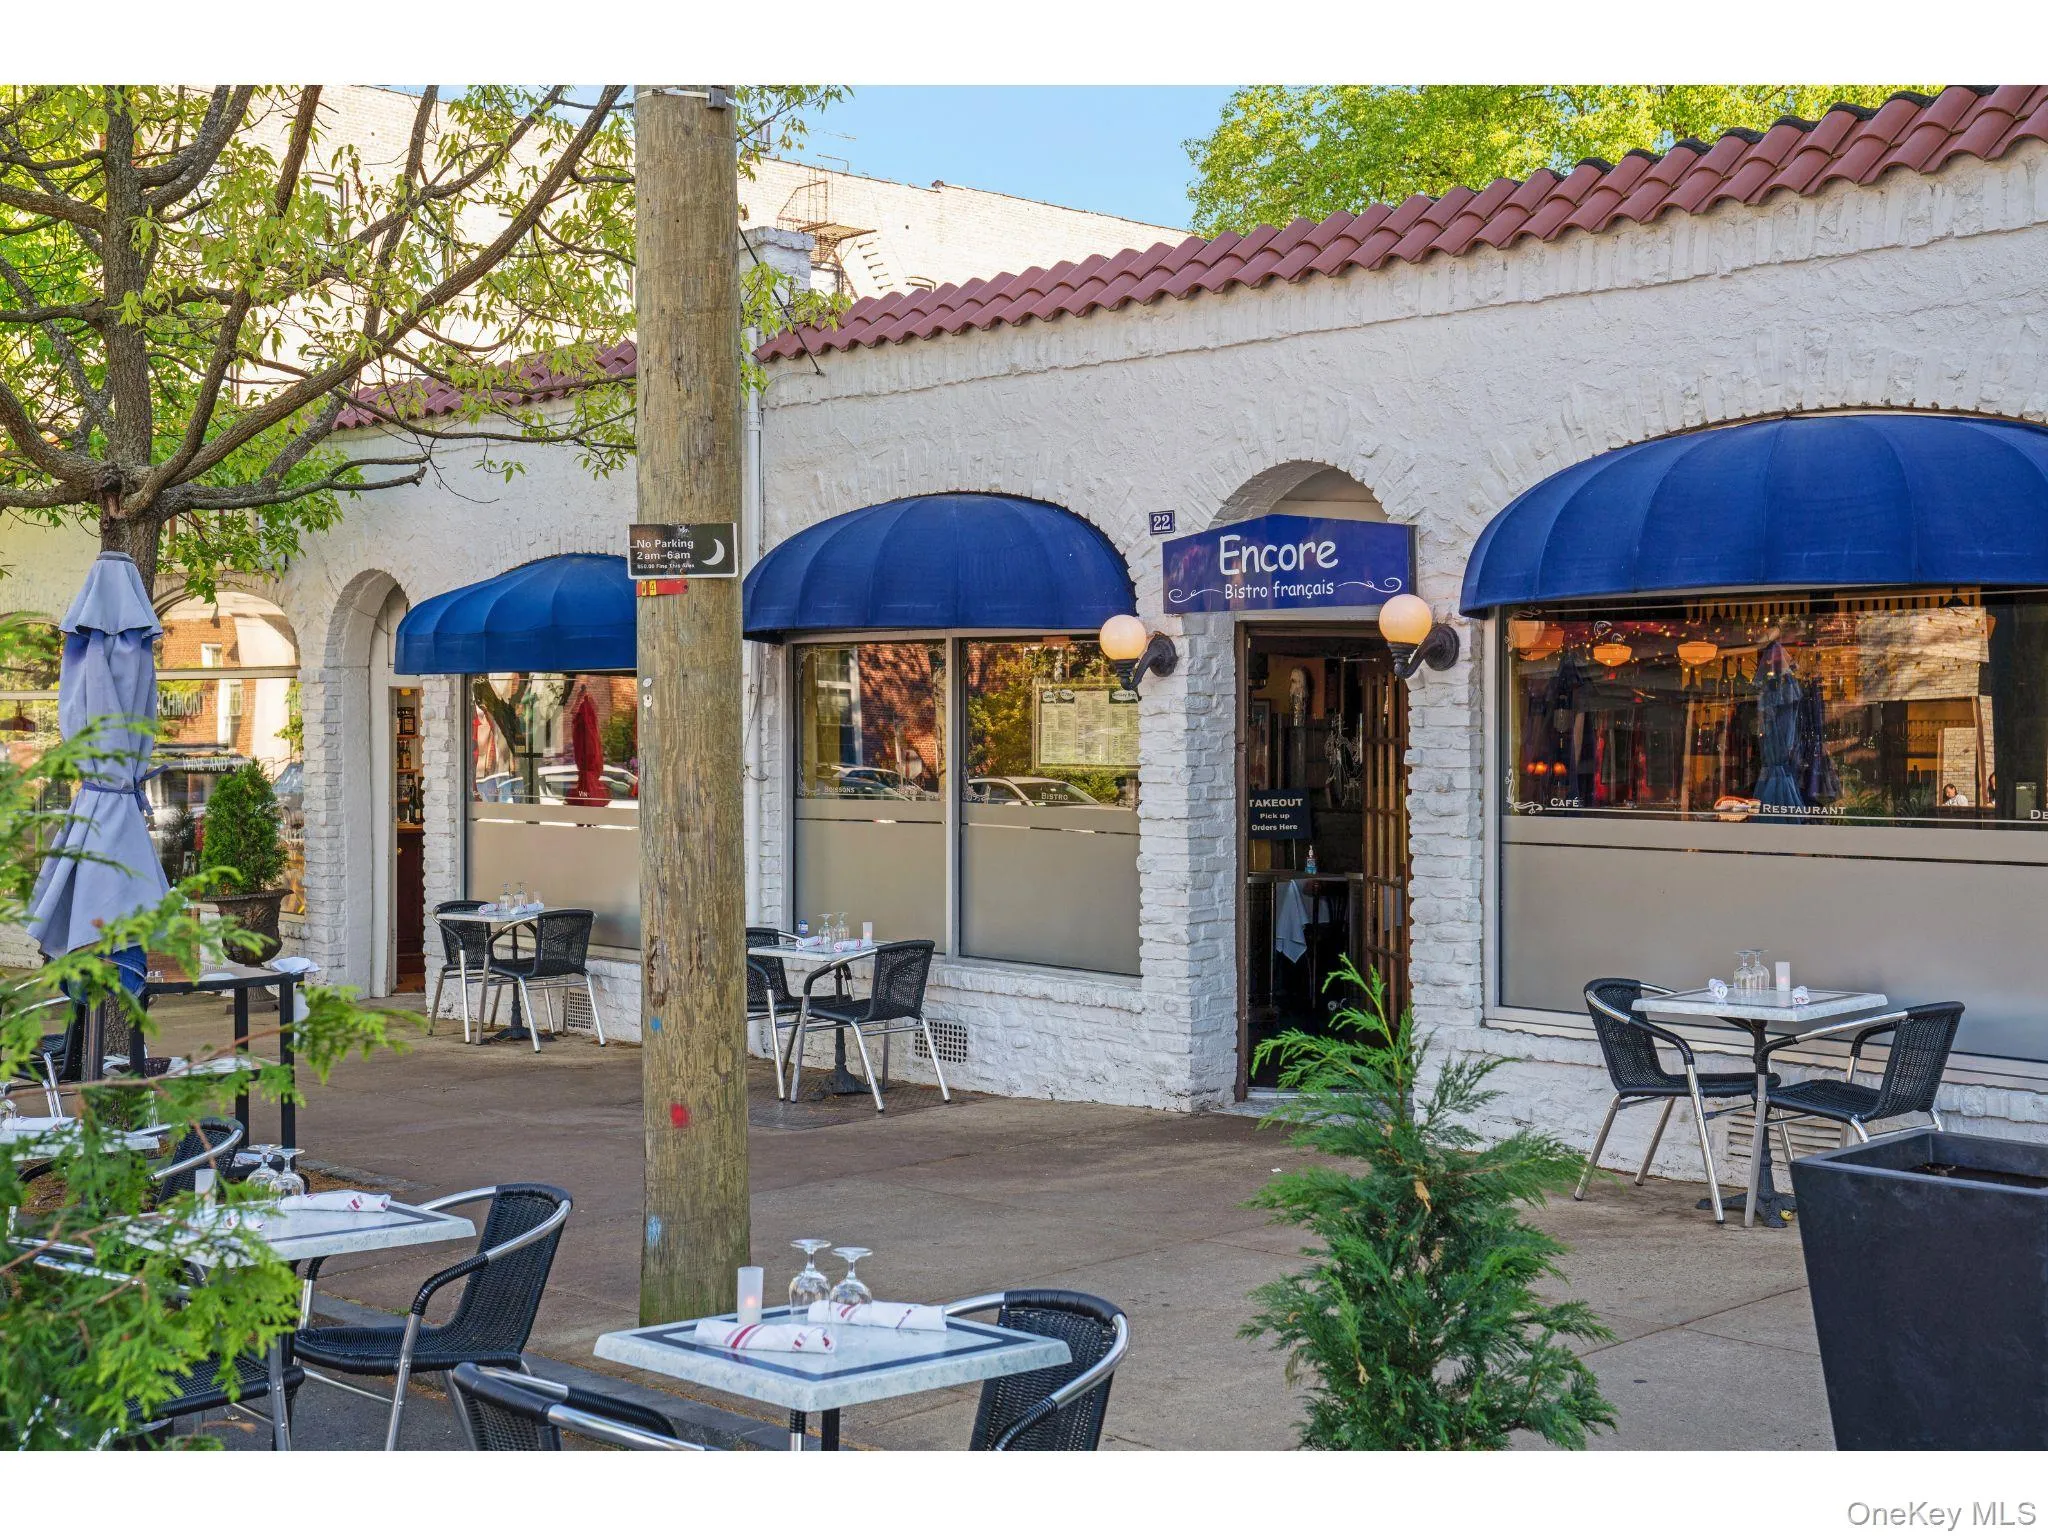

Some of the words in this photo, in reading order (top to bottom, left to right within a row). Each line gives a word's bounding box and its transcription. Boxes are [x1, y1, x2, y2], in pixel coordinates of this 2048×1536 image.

[1153, 514, 1171, 531] 22
[636, 540, 652, 549] No
[655, 539, 694, 549] Parking
[1219, 534, 1338, 576] Encore
[1225, 583, 1268, 600] Bistro
[1273, 579, 1334, 599] français
[182, 756, 205, 771] WINE
[208, 757, 228, 772] AND
[1249, 798, 1303, 808] TAKEOUT
[1762, 803, 1846, 815] RESTAURANT
[1279, 823, 1298, 831] Here
